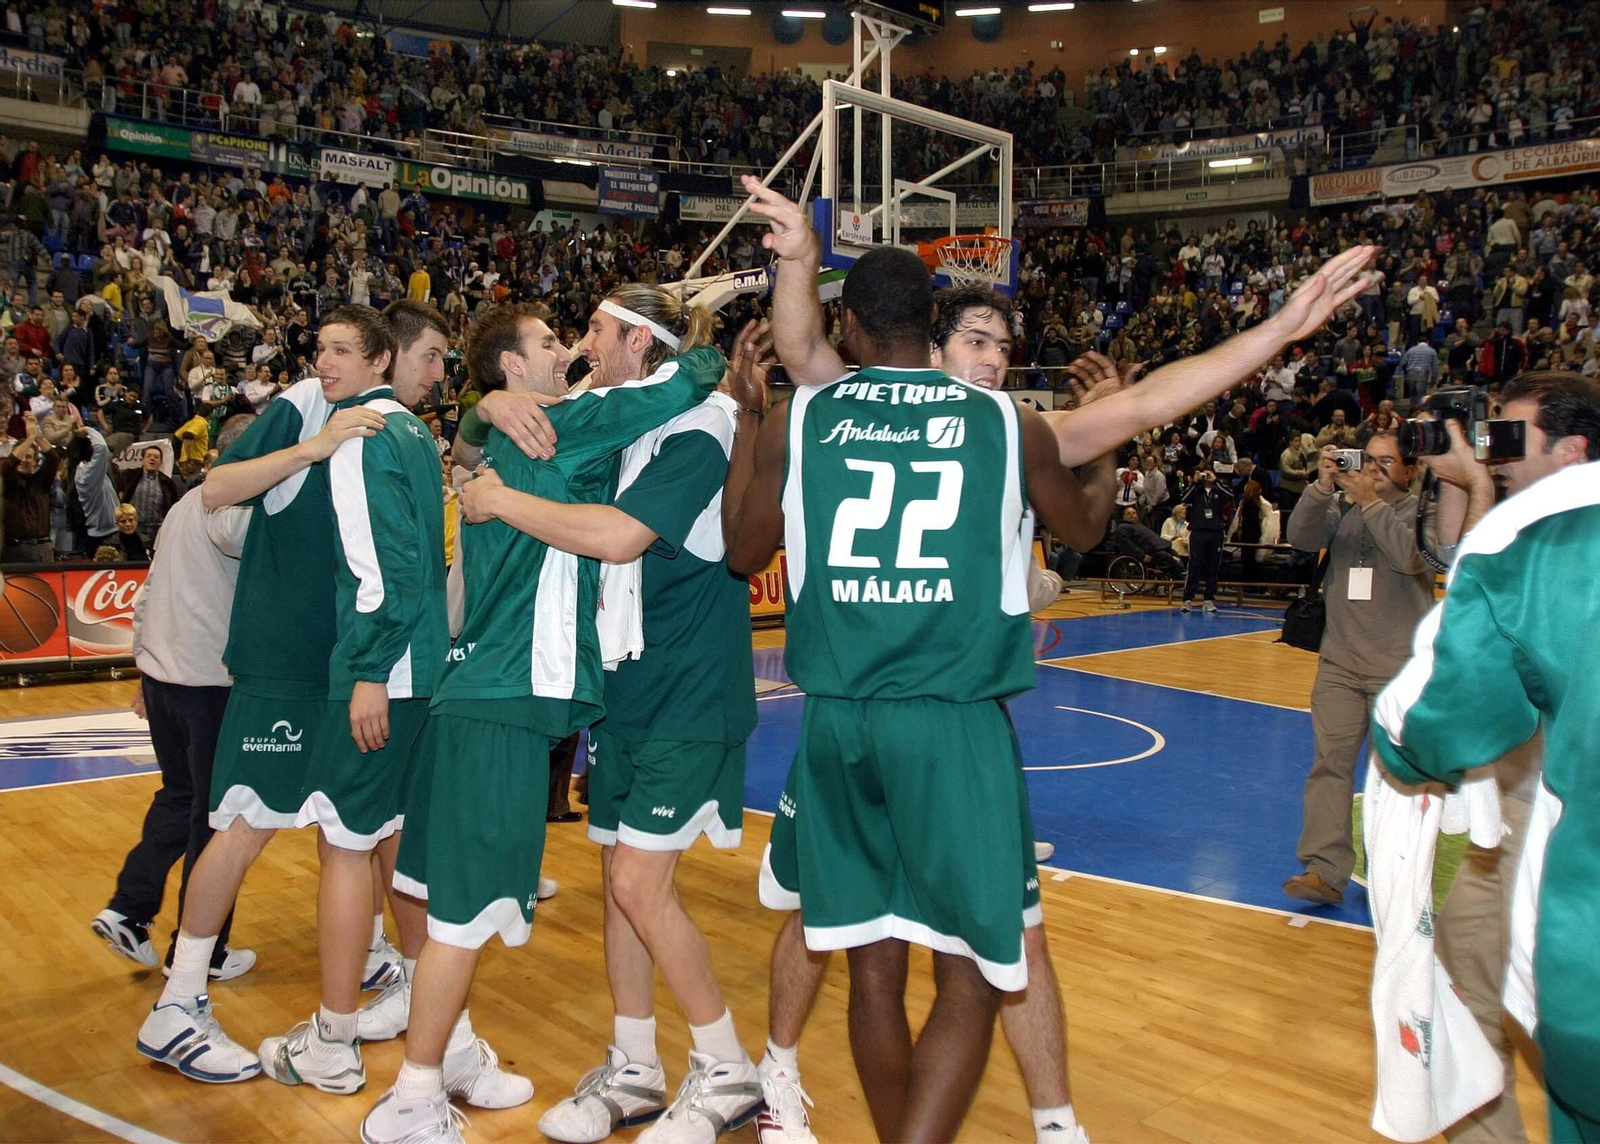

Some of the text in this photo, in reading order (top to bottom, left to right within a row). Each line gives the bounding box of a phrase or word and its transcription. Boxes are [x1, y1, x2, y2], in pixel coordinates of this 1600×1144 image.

[1254, 129, 1319, 149] Media
[325, 152, 392, 172] MASFALT
[1504, 150, 1518, 161] EL
[1512, 159, 1531, 171] DE
[715, 204, 731, 212] DEL
[842, 230, 871, 243] Euroleague
[832, 382, 967, 405] PIETRUS
[827, 458, 964, 569] 22
[831, 575, 954, 603] MÁLAGA
[242, 743, 302, 752] evemarina
